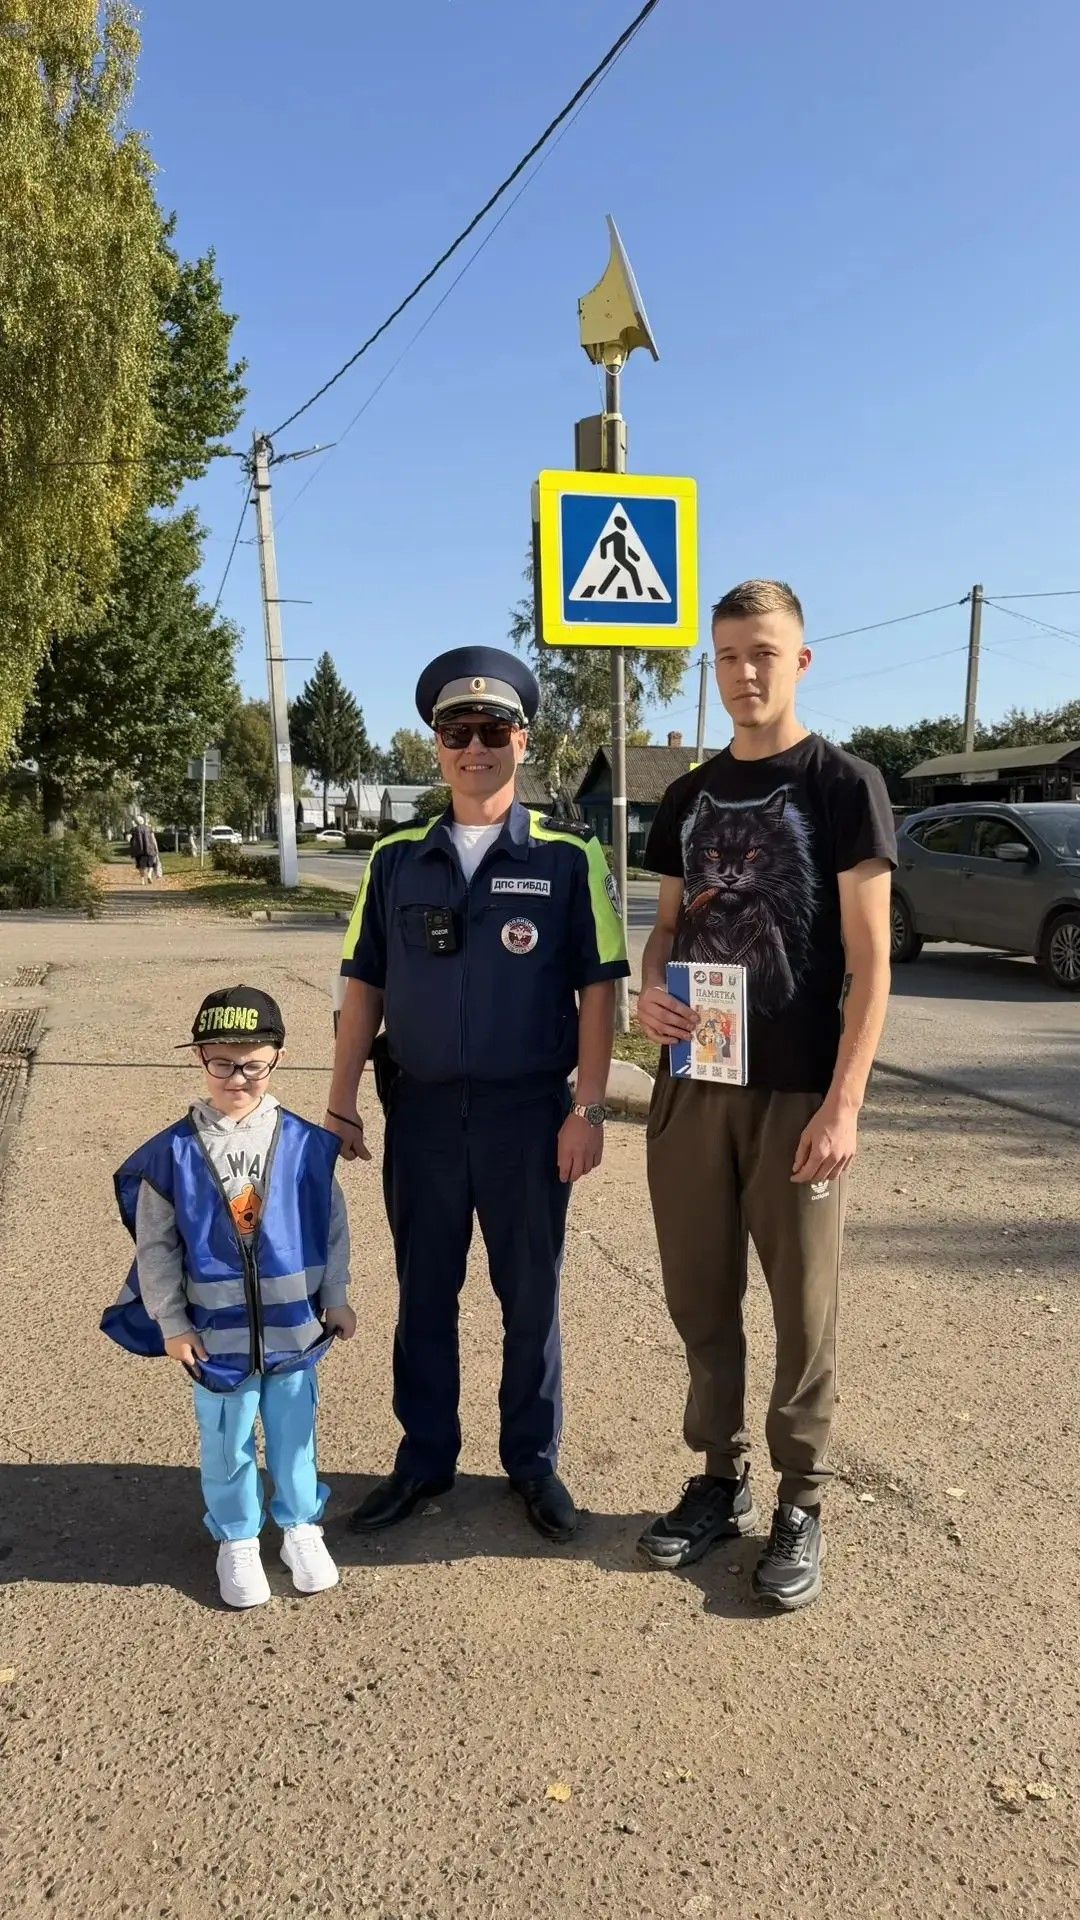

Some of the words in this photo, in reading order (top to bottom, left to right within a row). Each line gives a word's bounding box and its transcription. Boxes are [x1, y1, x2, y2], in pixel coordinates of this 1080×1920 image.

[494, 880, 515, 890] ДПС
[517, 881, 549, 893] ГИБДД
[695, 988, 736, 1000] ПАМЯТКА
[198, 1006, 259, 1032] STRONG
